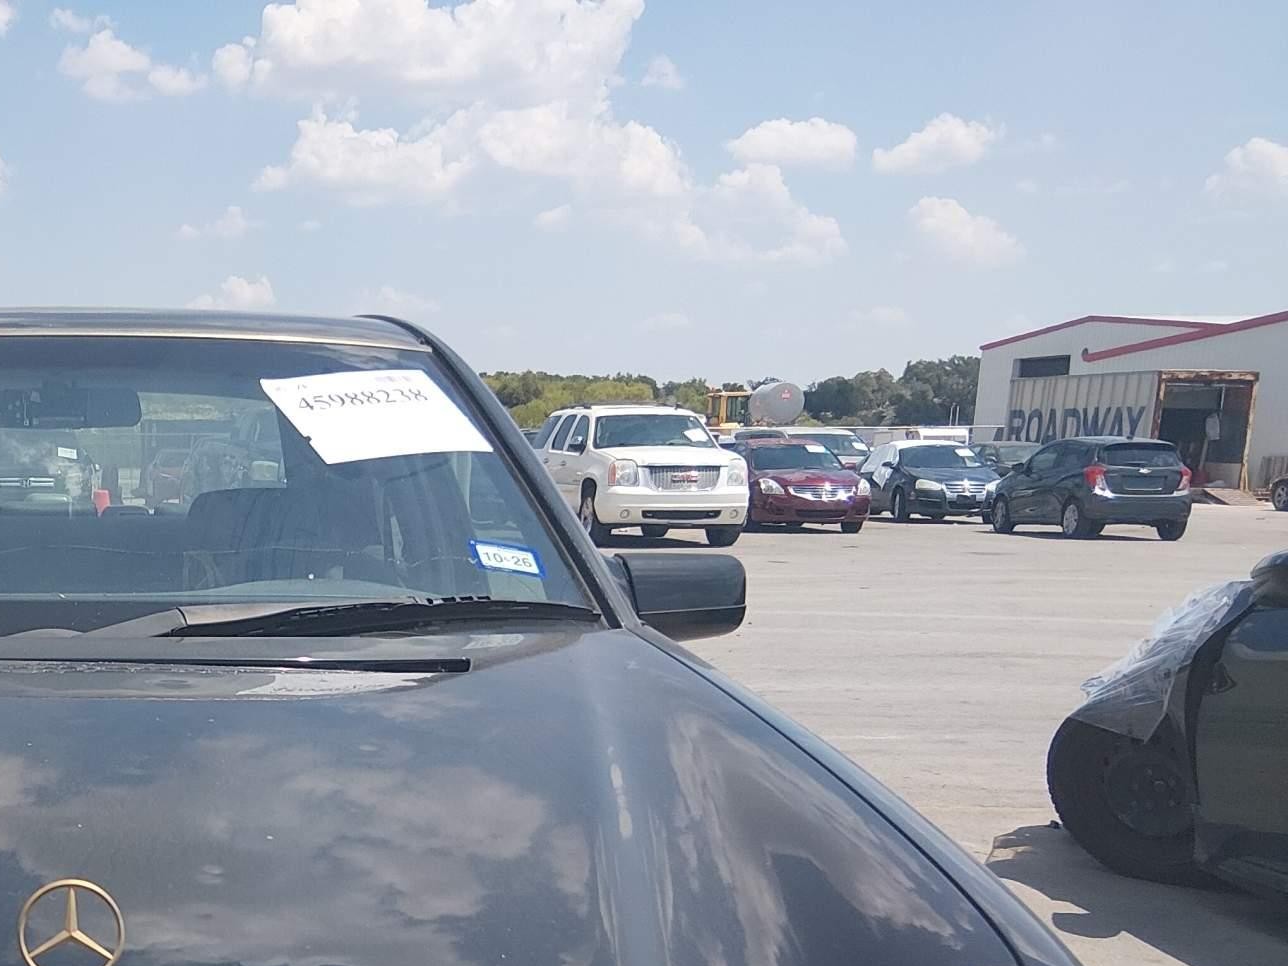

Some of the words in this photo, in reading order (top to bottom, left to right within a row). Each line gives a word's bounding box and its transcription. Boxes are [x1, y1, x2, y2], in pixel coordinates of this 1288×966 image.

[298, 388, 429, 410] 45988238
[1008, 406, 1147, 444] ROADWAY
[482, 551, 533, 568] 10-26
